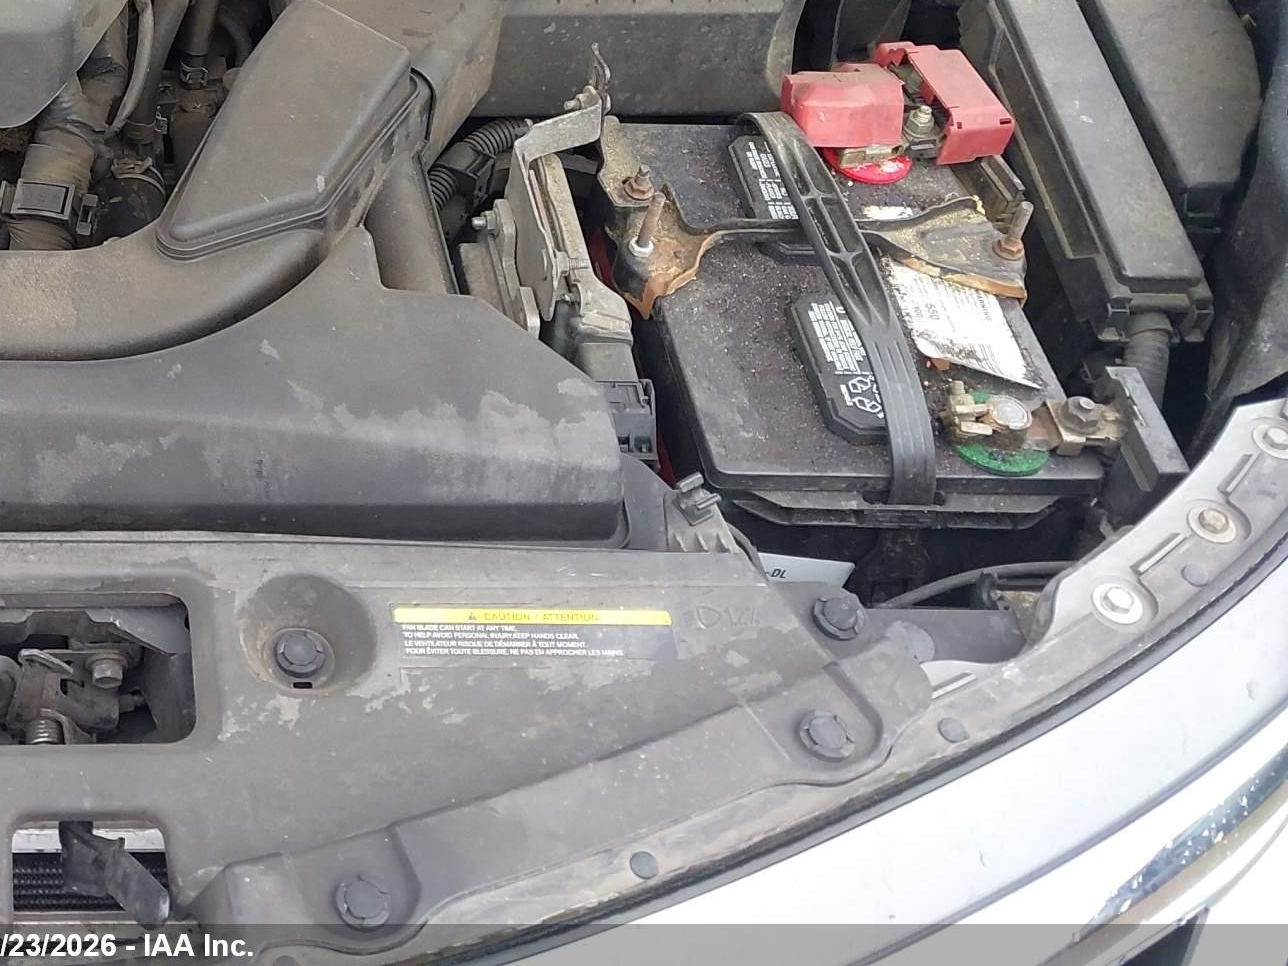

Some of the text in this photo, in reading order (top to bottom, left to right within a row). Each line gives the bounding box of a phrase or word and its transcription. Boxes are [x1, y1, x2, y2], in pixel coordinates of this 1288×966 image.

[484, 612, 531, 621] CAUTION
[542, 613, 600, 622] ATTENTION
[455, 624, 475, 632] START
[476, 624, 485, 632] AT
[486, 624, 499, 632] ANY
[403, 631, 413, 639] TO
[414, 631, 431, 639] HELP
[531, 632, 555, 640] HANDS
[414, 640, 457, 648] VENTILATEUR
[458, 640, 482, 648] RISQUE
[406, 647, 426, 655] POUR
[450, 647, 472, 655] TOUTE
[510, 648, 520, 656] NE
[520, 648, 534, 656] PAS
[545, 648, 587, 656] APPROCHER
[587, 648, 600, 656] LES
